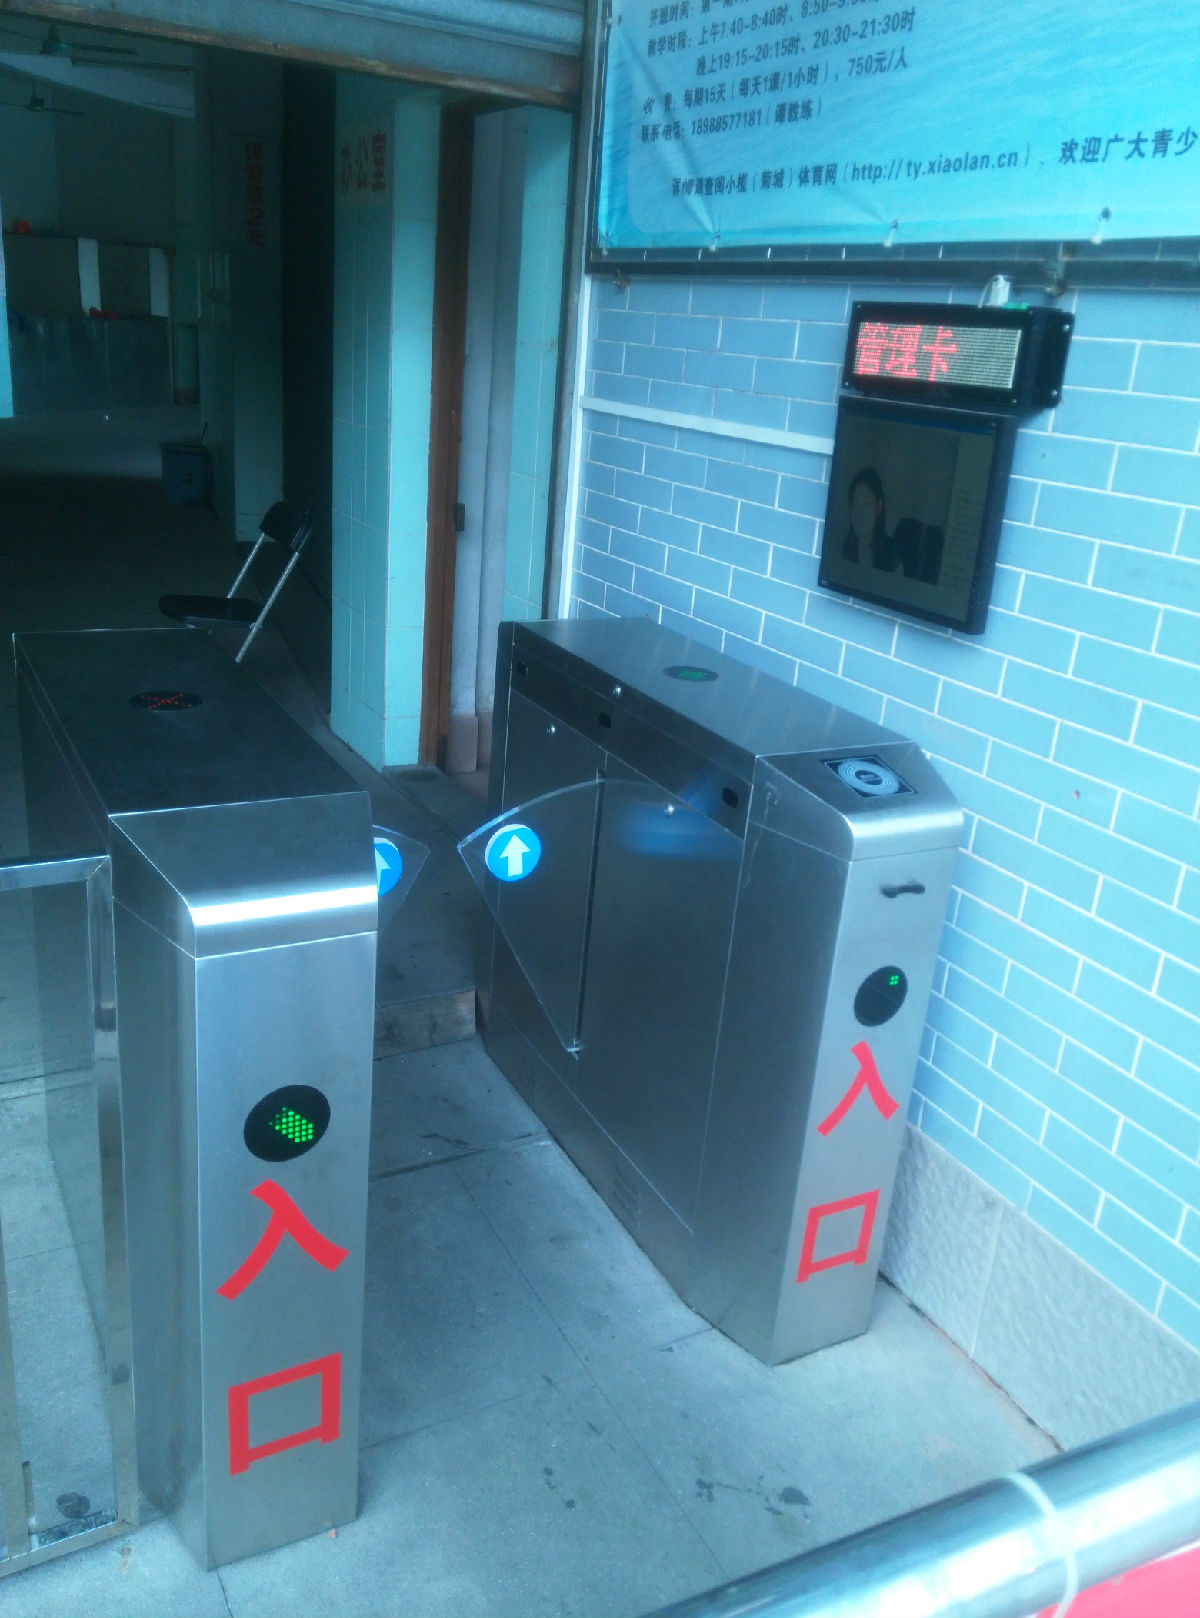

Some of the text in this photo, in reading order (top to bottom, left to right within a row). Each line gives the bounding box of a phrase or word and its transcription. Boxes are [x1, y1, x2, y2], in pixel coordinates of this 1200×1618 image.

[856, 321, 958, 382] 管理卡
[796, 1039, 900, 1284] 入口
[215, 1178, 350, 1477] 入口
